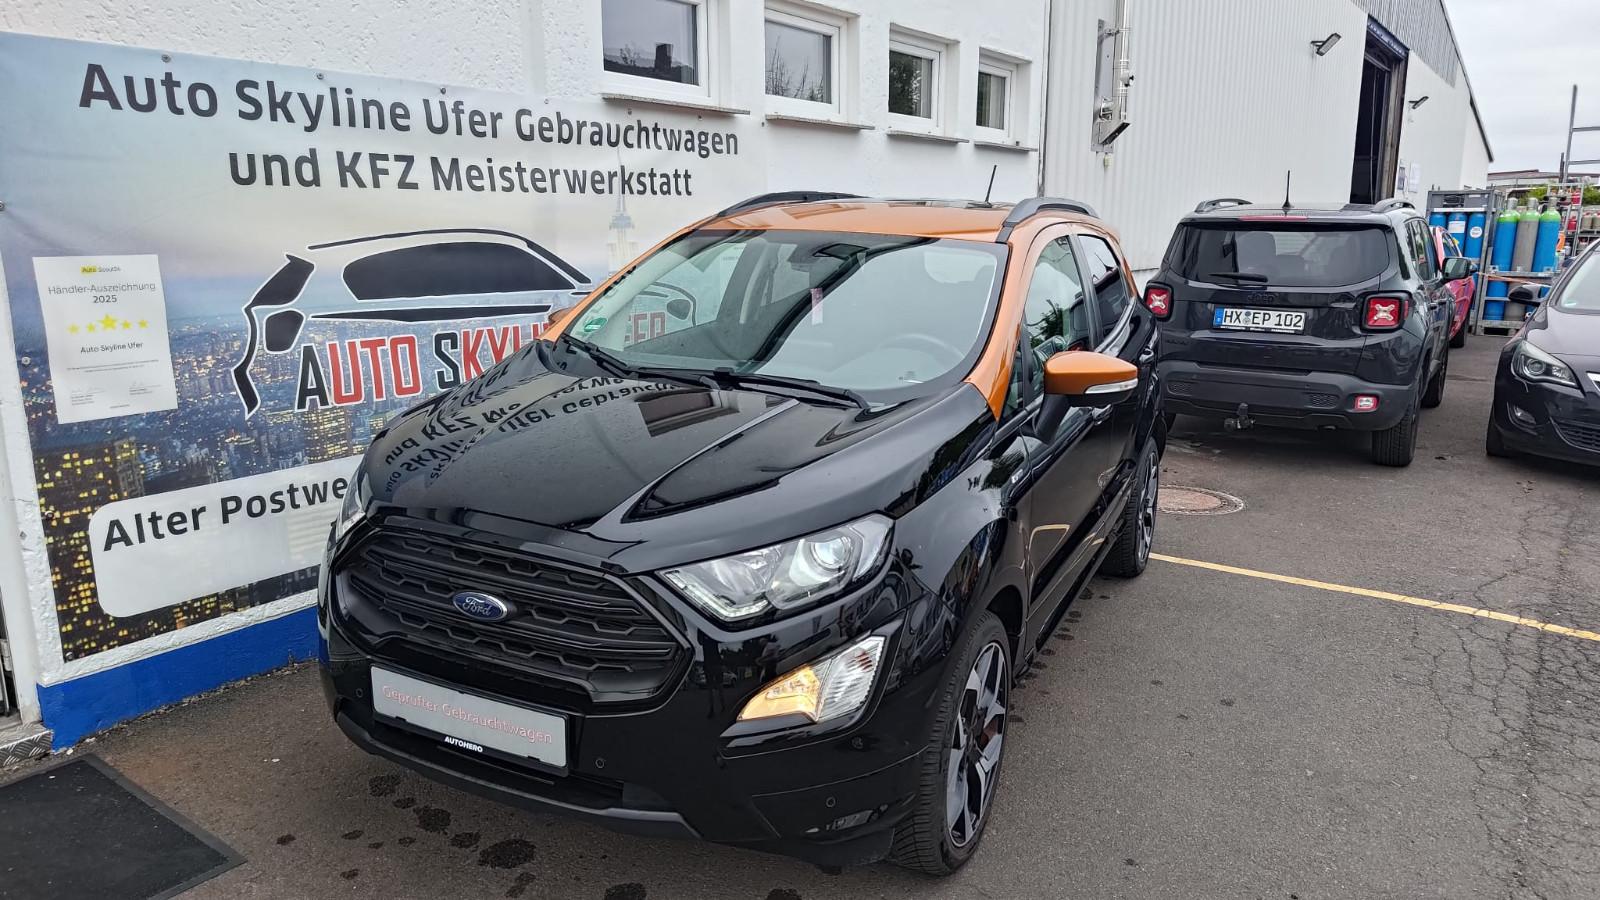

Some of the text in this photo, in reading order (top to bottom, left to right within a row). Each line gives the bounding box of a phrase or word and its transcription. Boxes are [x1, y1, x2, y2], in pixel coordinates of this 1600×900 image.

[79, 63, 738, 158] Auto Skyline Ufer Gebrauchtwagen
[229, 149, 692, 196] und KFZ Meisterwerkstatt
[48, 282, 156, 295] Händler-Auszeichnung
[93, 294, 118, 304] 2025
[1223, 310, 1303, 328] HX EP 102
[80, 341, 144, 353] Auto Skyline Ufer
[297, 336, 421, 411] AUTO
[104, 477, 350, 551] Alter Postwe
[463, 596, 492, 616] Ford
[442, 703, 553, 744] Gebrauchtwagen
[444, 735, 484, 753] AUTOHERO
